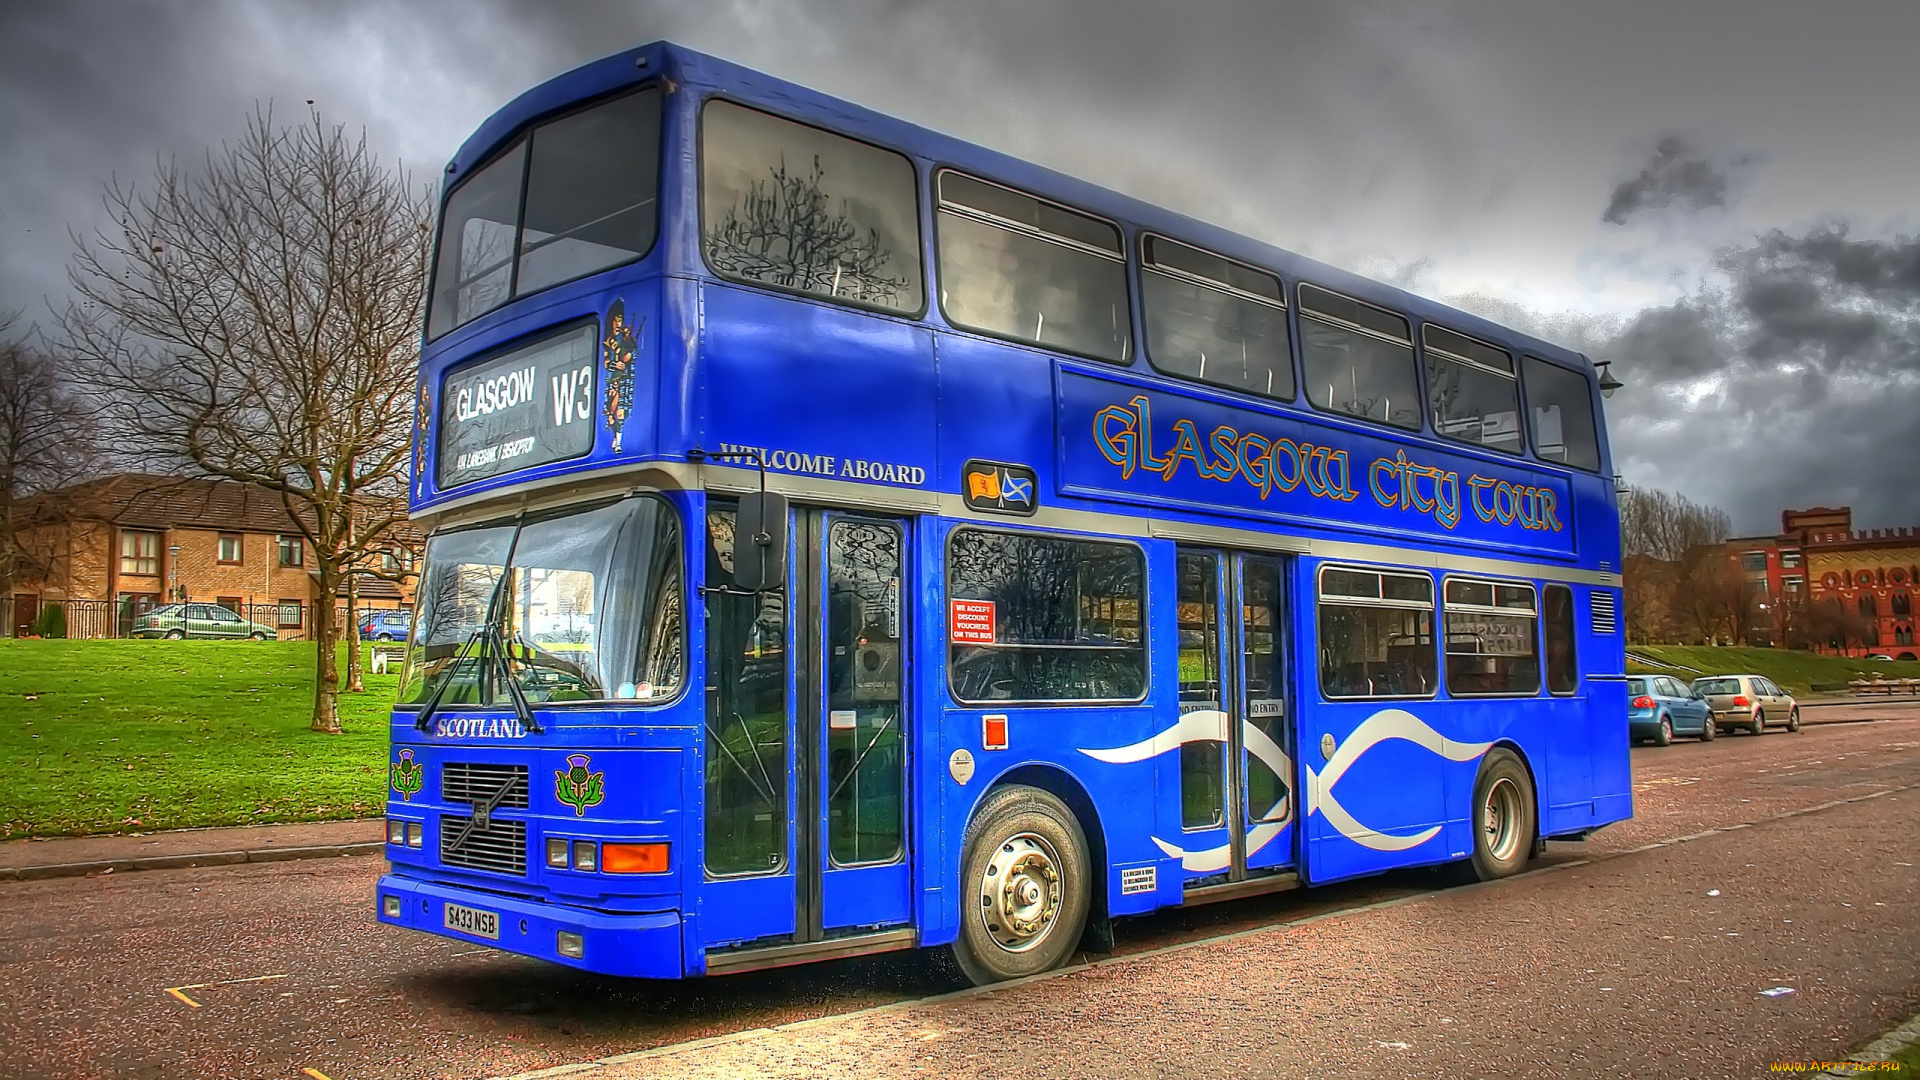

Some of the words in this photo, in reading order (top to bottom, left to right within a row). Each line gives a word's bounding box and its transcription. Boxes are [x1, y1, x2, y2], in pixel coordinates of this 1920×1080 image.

[457, 366, 536, 422] GLASGOW
[552, 365, 592, 427] W3
[719, 442, 836, 477] WELCOME
[840, 458, 926, 485] ABOARD
[1092, 395, 1360, 501] GLASGOW
[1466, 473, 1563, 533] TOUR
[956, 604, 966, 612] WE
[967, 604, 990, 613] ACCEPT
[957, 613, 989, 621] DISCOUNT
[956, 622, 990, 630] VOUCHERS
[965, 631, 979, 639] THIS
[1260, 703, 1279, 713] ENTRY
[436, 718, 528, 739] SCOTLAND
[448, 906, 472, 929] S433
[474, 911, 495, 934] NSB
